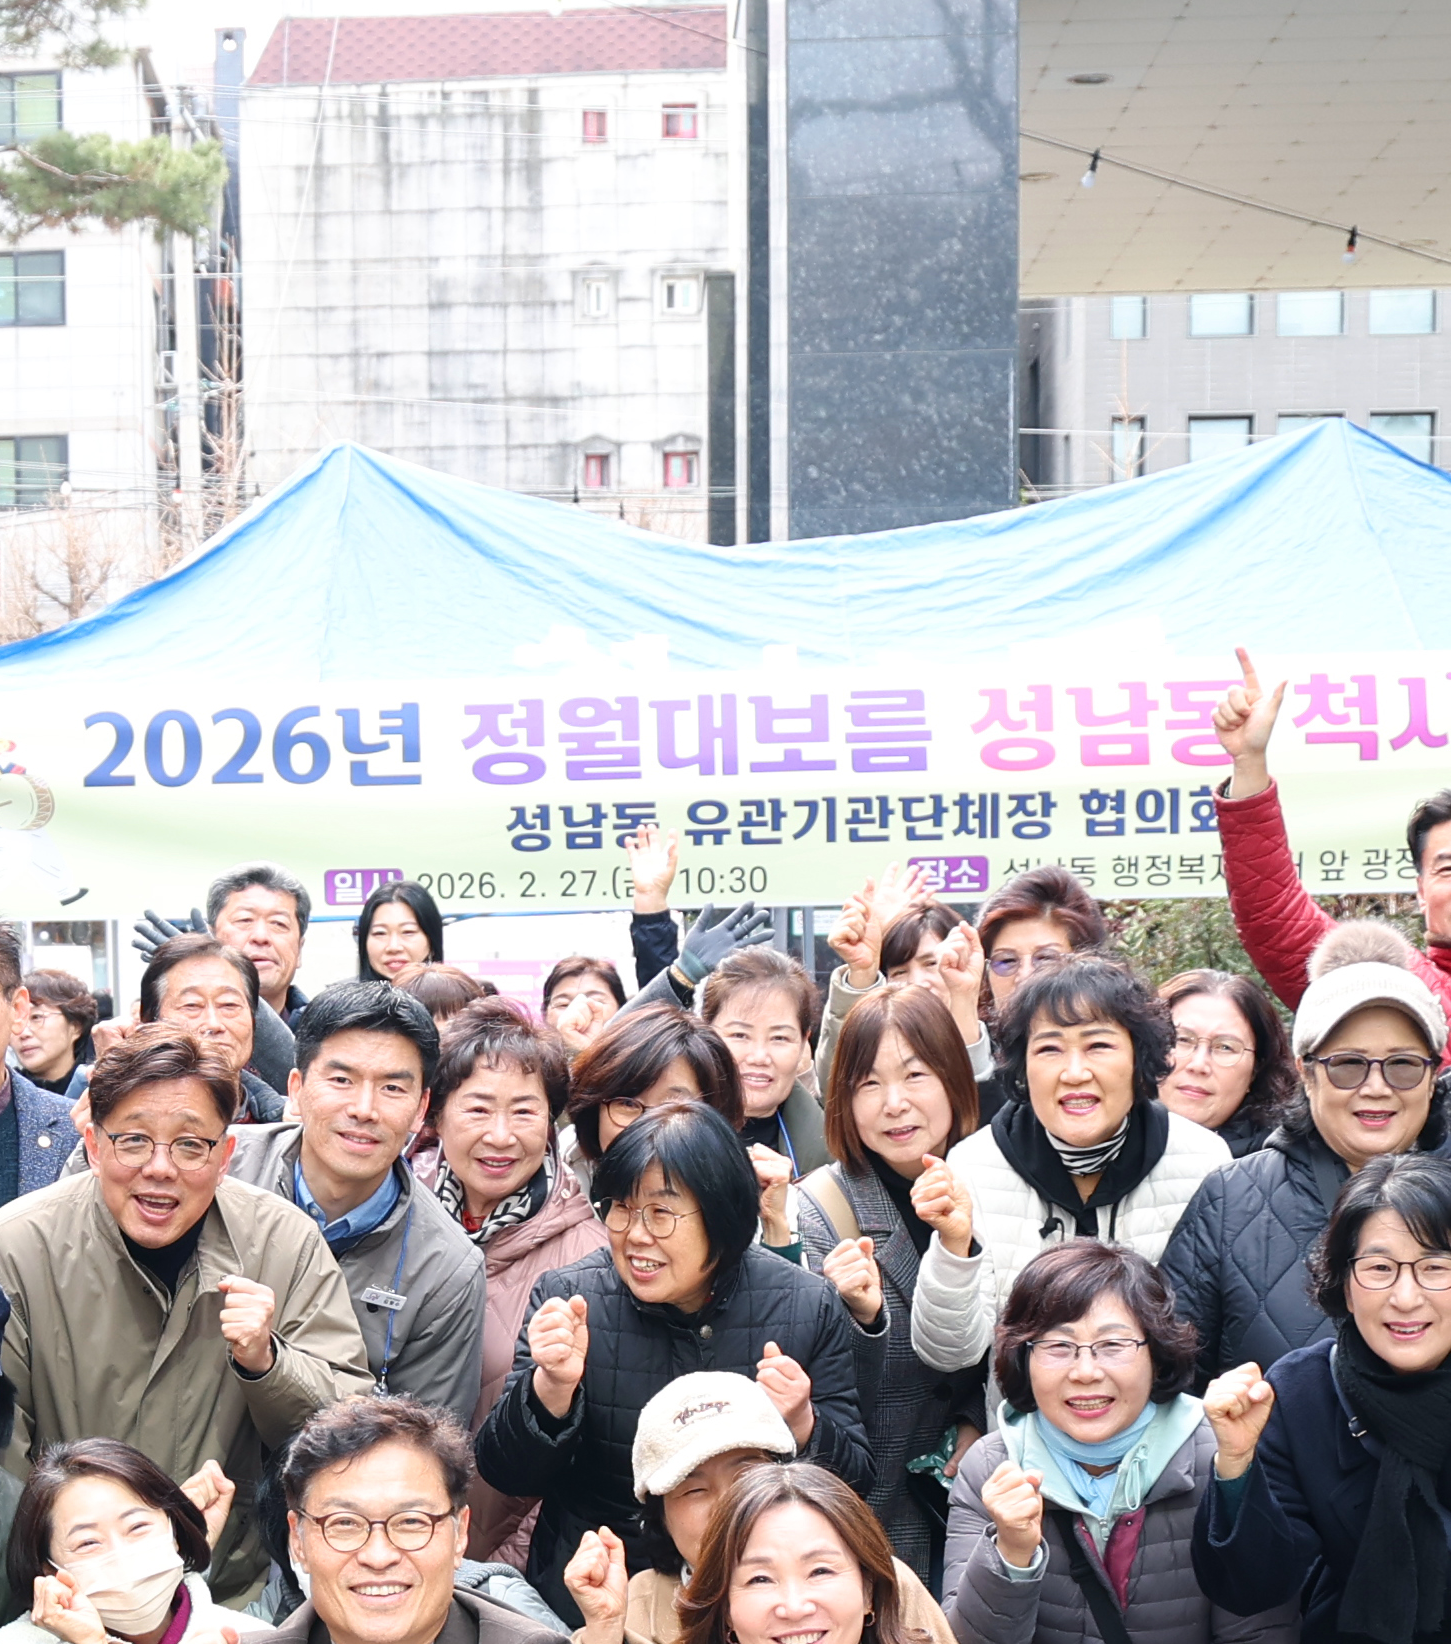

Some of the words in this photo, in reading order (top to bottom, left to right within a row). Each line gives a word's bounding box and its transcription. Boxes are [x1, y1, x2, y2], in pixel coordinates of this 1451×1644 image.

[82, 701, 423, 788] 2026년
[460, 689, 932, 786] 정월대보름
[969, 680, 1237, 772] 성남동
[505, 801, 660, 851] 성남동
[684, 791, 1057, 847] 유관기관단체장
[923, 859, 984, 891] 장소
[1320, 848, 1348, 880] 앞
[419, 872, 506, 899] 2026.
[519, 871, 546, 898] 2.
[680, 866, 768, 894] 10:30
